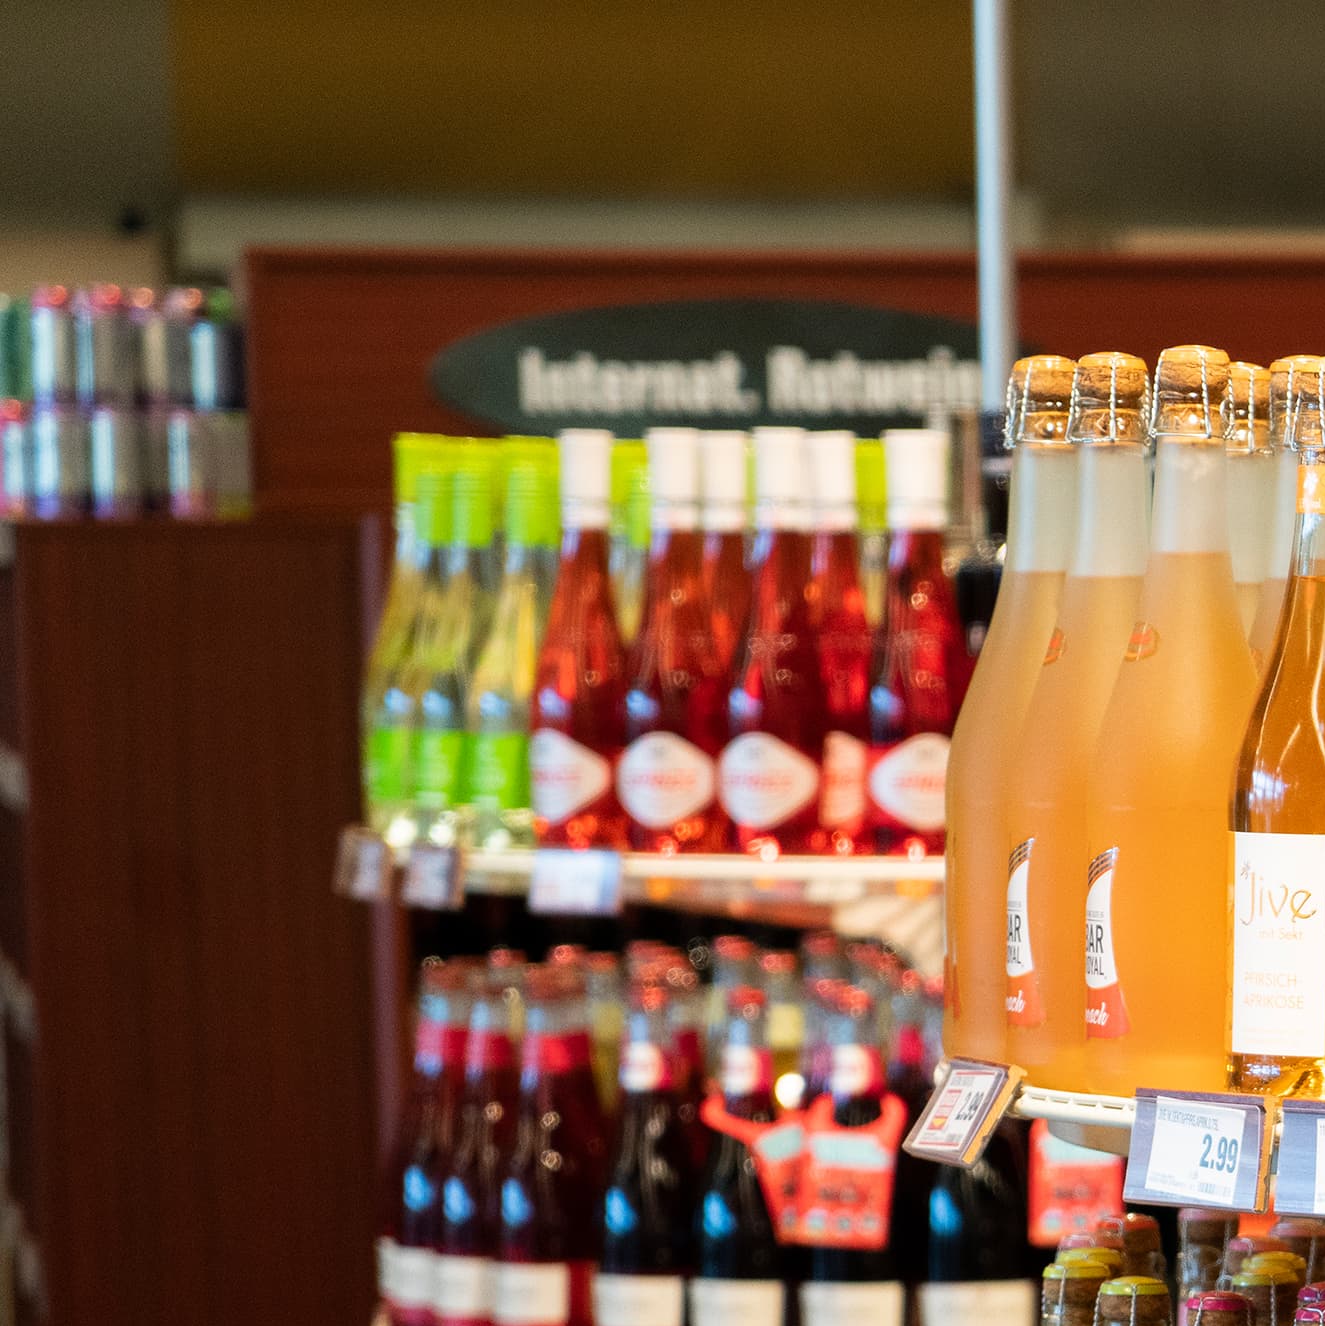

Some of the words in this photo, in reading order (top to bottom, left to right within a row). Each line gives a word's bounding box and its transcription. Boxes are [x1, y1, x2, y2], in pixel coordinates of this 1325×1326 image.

[1241, 871, 1317, 926] Jive
[1007, 914, 1021, 942] AR
[1199, 1134, 1238, 1173] 2.99
